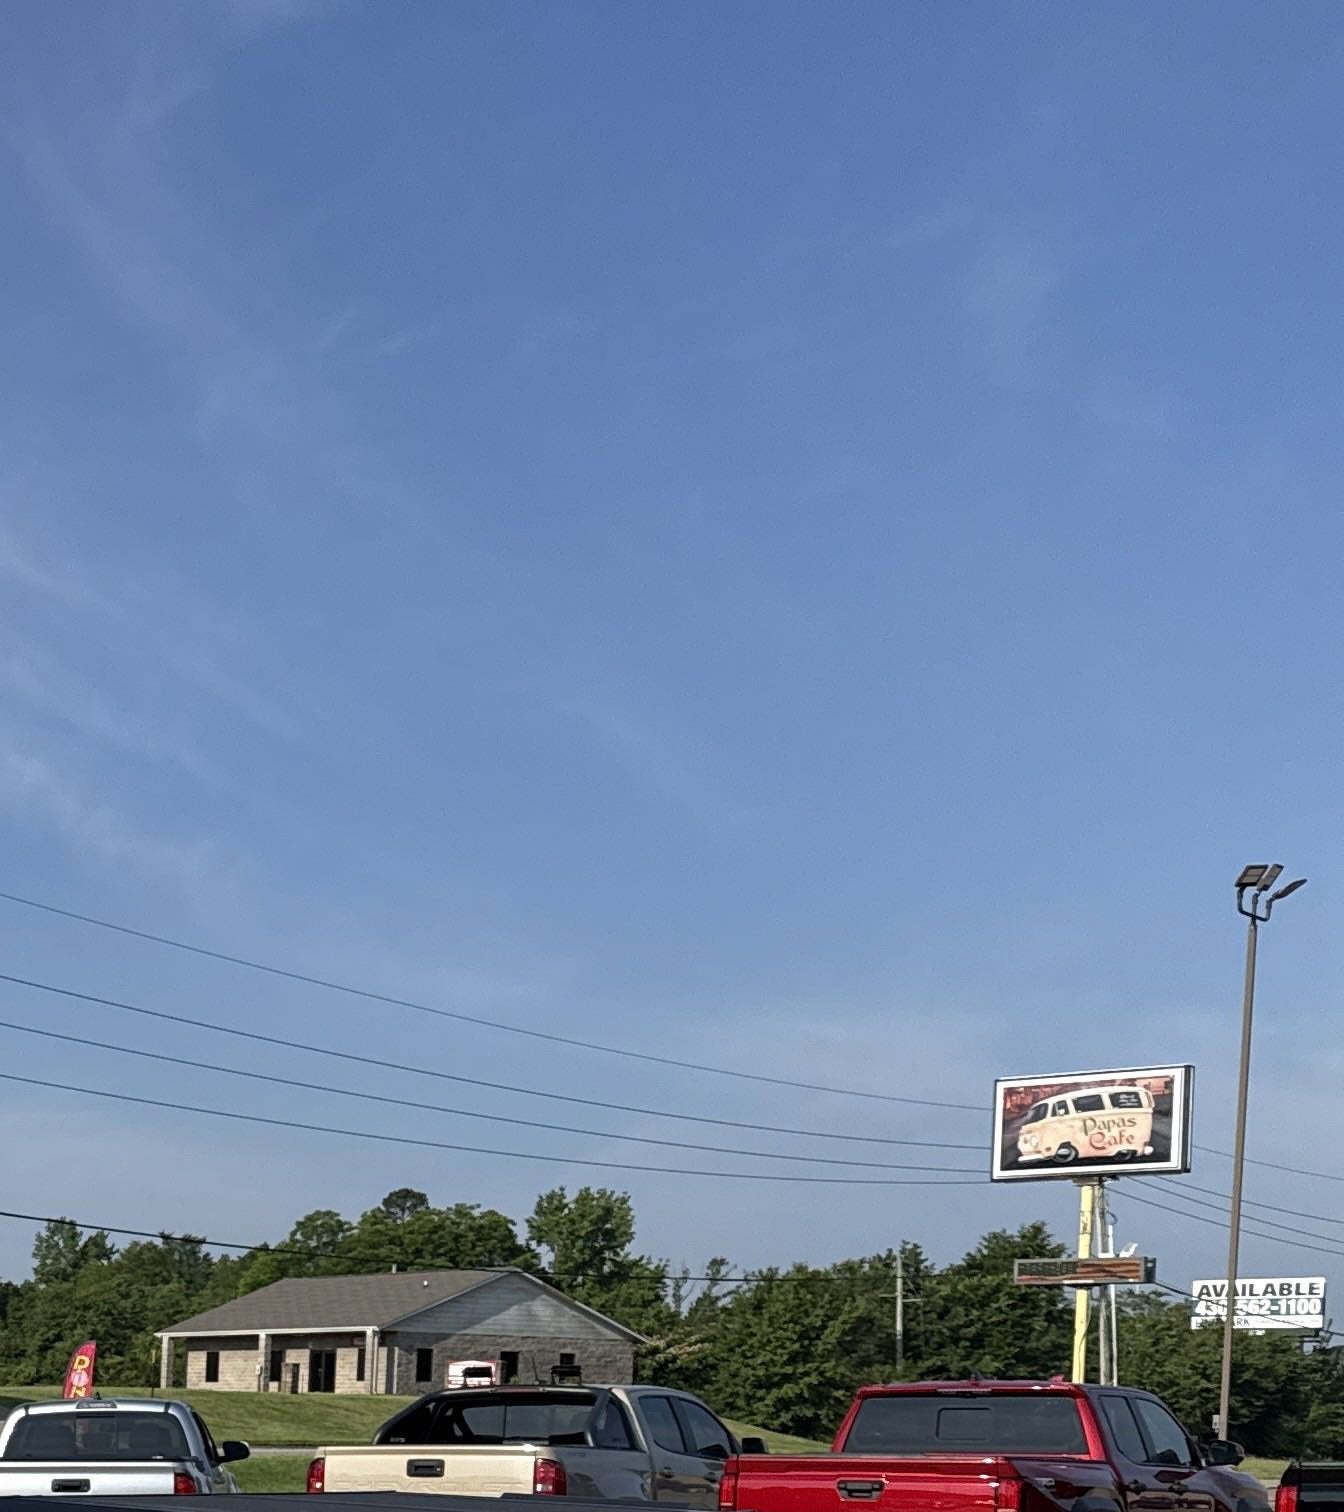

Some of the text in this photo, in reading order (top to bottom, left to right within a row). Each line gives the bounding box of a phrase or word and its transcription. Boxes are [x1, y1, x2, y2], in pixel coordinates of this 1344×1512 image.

[1081, 1116, 1137, 1136] Papas
[1089, 1131, 1135, 1150] Cafe
[1194, 1298, 1322, 1316] 430562-1100
